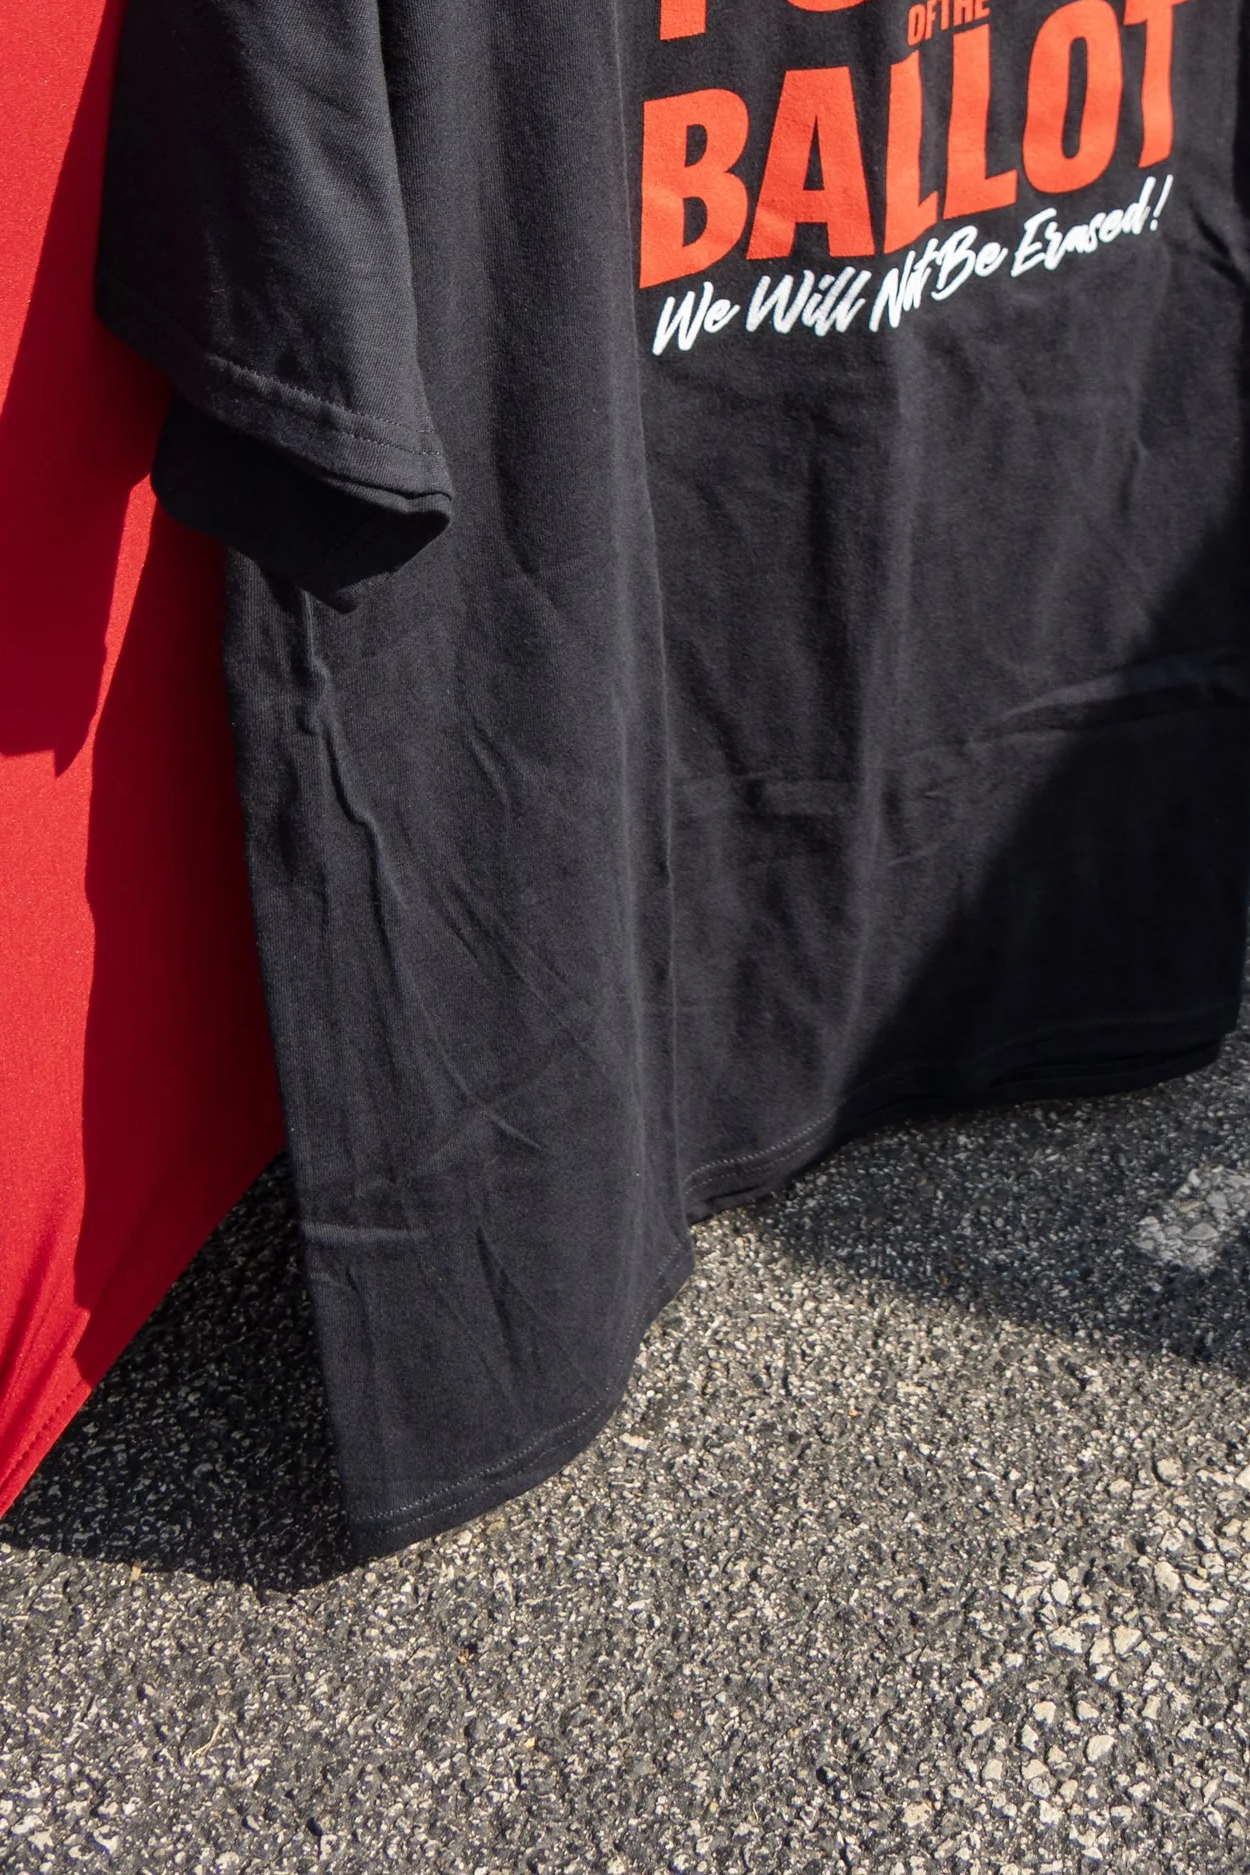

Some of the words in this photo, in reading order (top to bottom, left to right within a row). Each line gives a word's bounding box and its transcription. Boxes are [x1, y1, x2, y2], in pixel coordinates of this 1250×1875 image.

[652, 281, 740, 356] We
[746, 266, 872, 337] Will
[931, 225, 1008, 301] Be
[1011, 174, 1173, 277] Erased!
